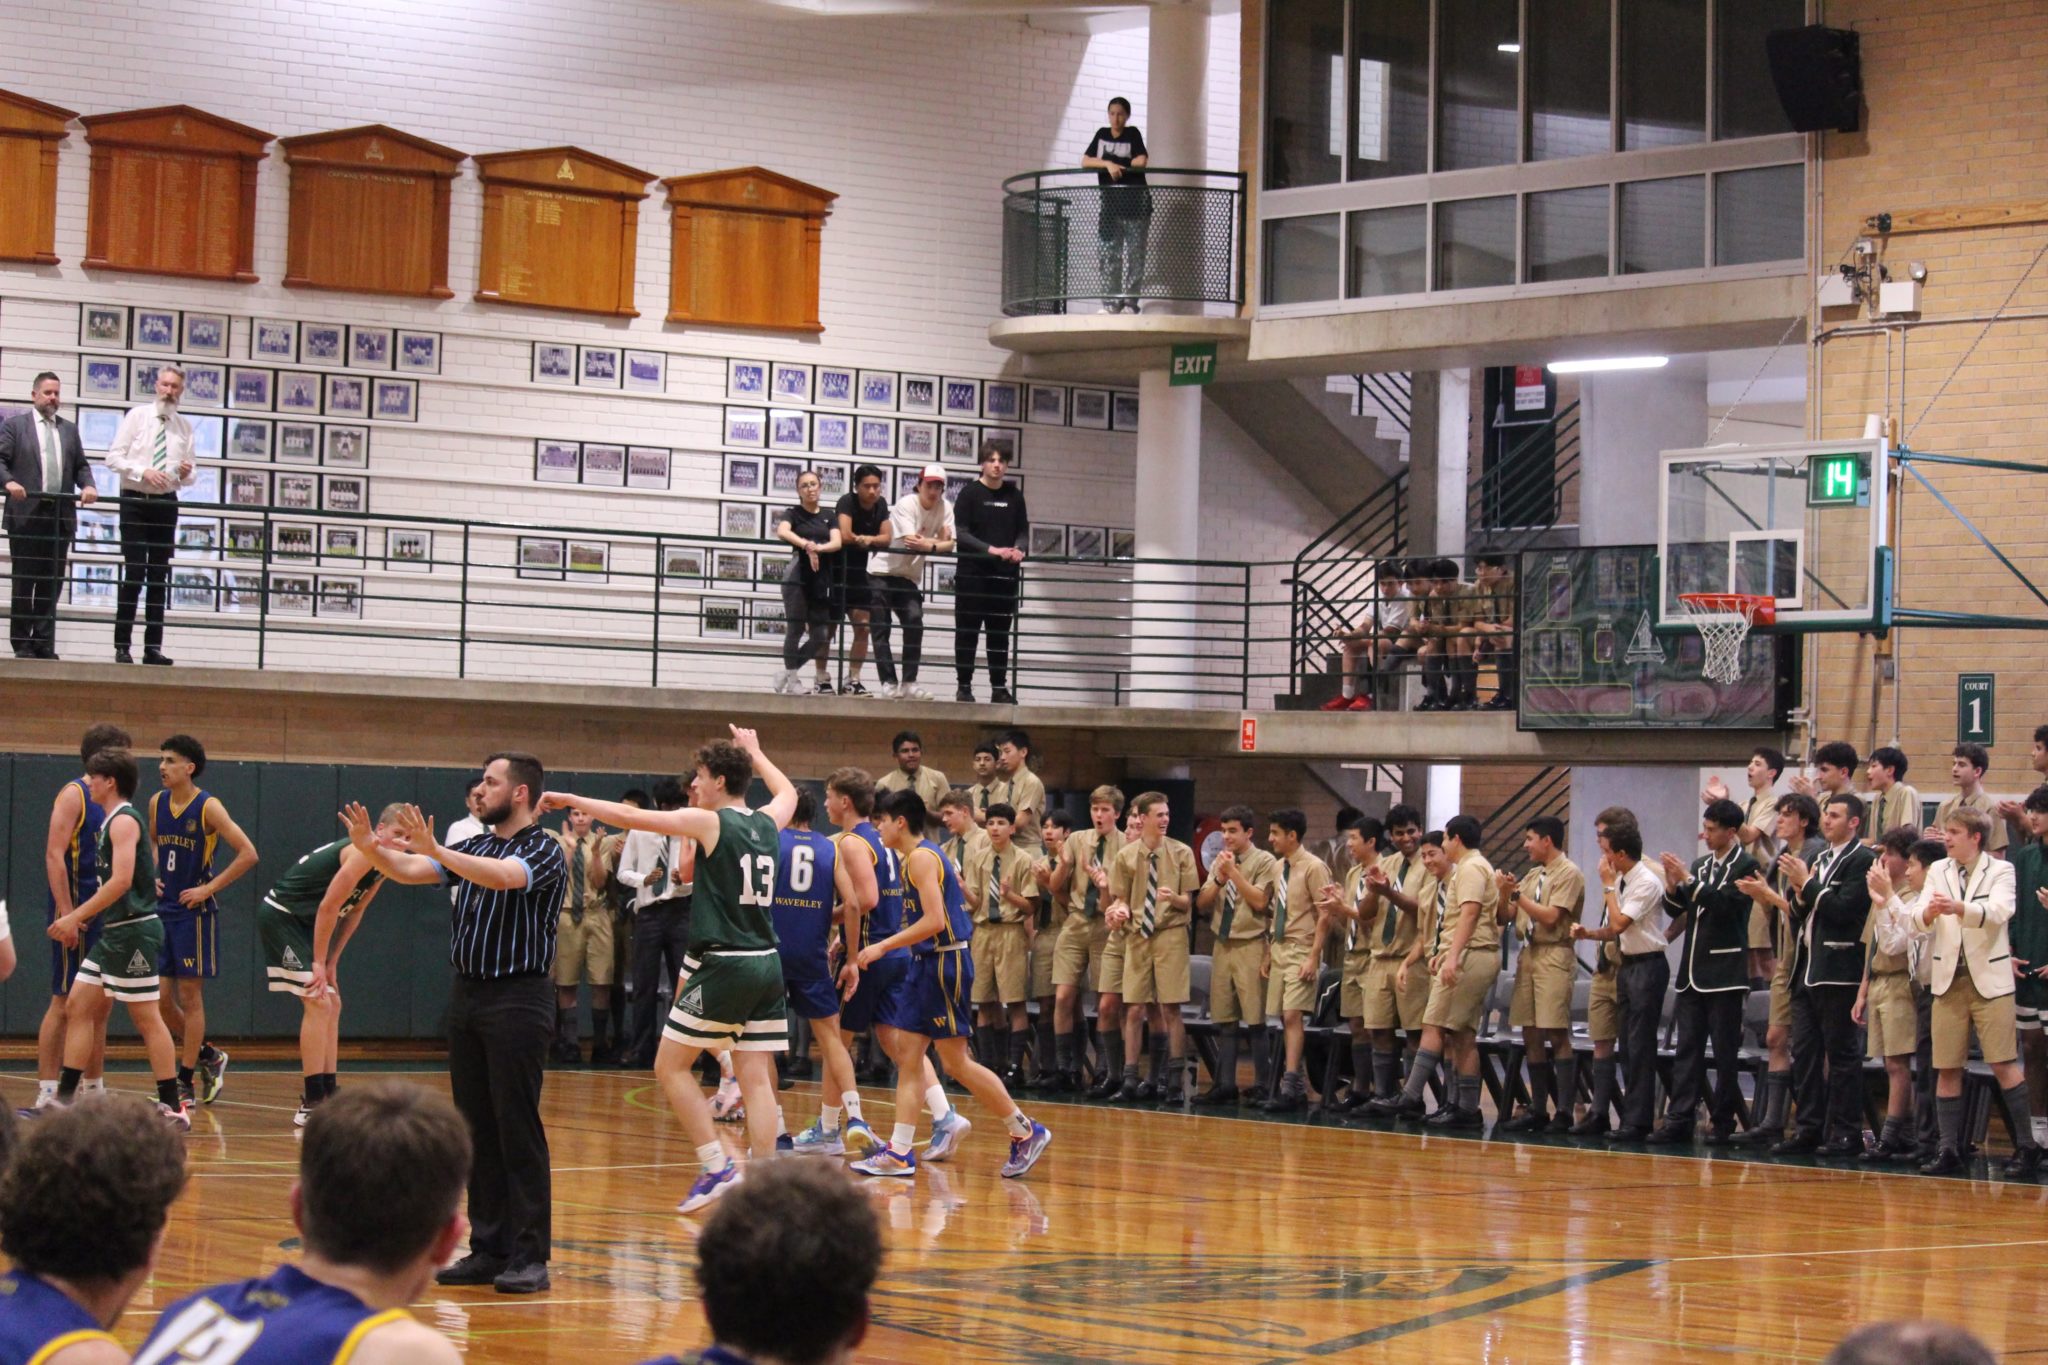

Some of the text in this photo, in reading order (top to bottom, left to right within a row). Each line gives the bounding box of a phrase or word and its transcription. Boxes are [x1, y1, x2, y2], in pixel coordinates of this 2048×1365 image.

[1174, 355, 1213, 375] EXIT
[1827, 461, 1853, 496] 14
[1964, 682, 1989, 691] COURT
[1968, 697, 1984, 733] 1
[157, 834, 197, 852] WAVERLEY
[166, 850, 176, 872] 8
[789, 844, 815, 893] 6
[739, 853, 775, 907] 13
[775, 897, 824, 910] WAVERLEY
[183, 957, 195, 968] W
[933, 1016, 947, 1029] W
